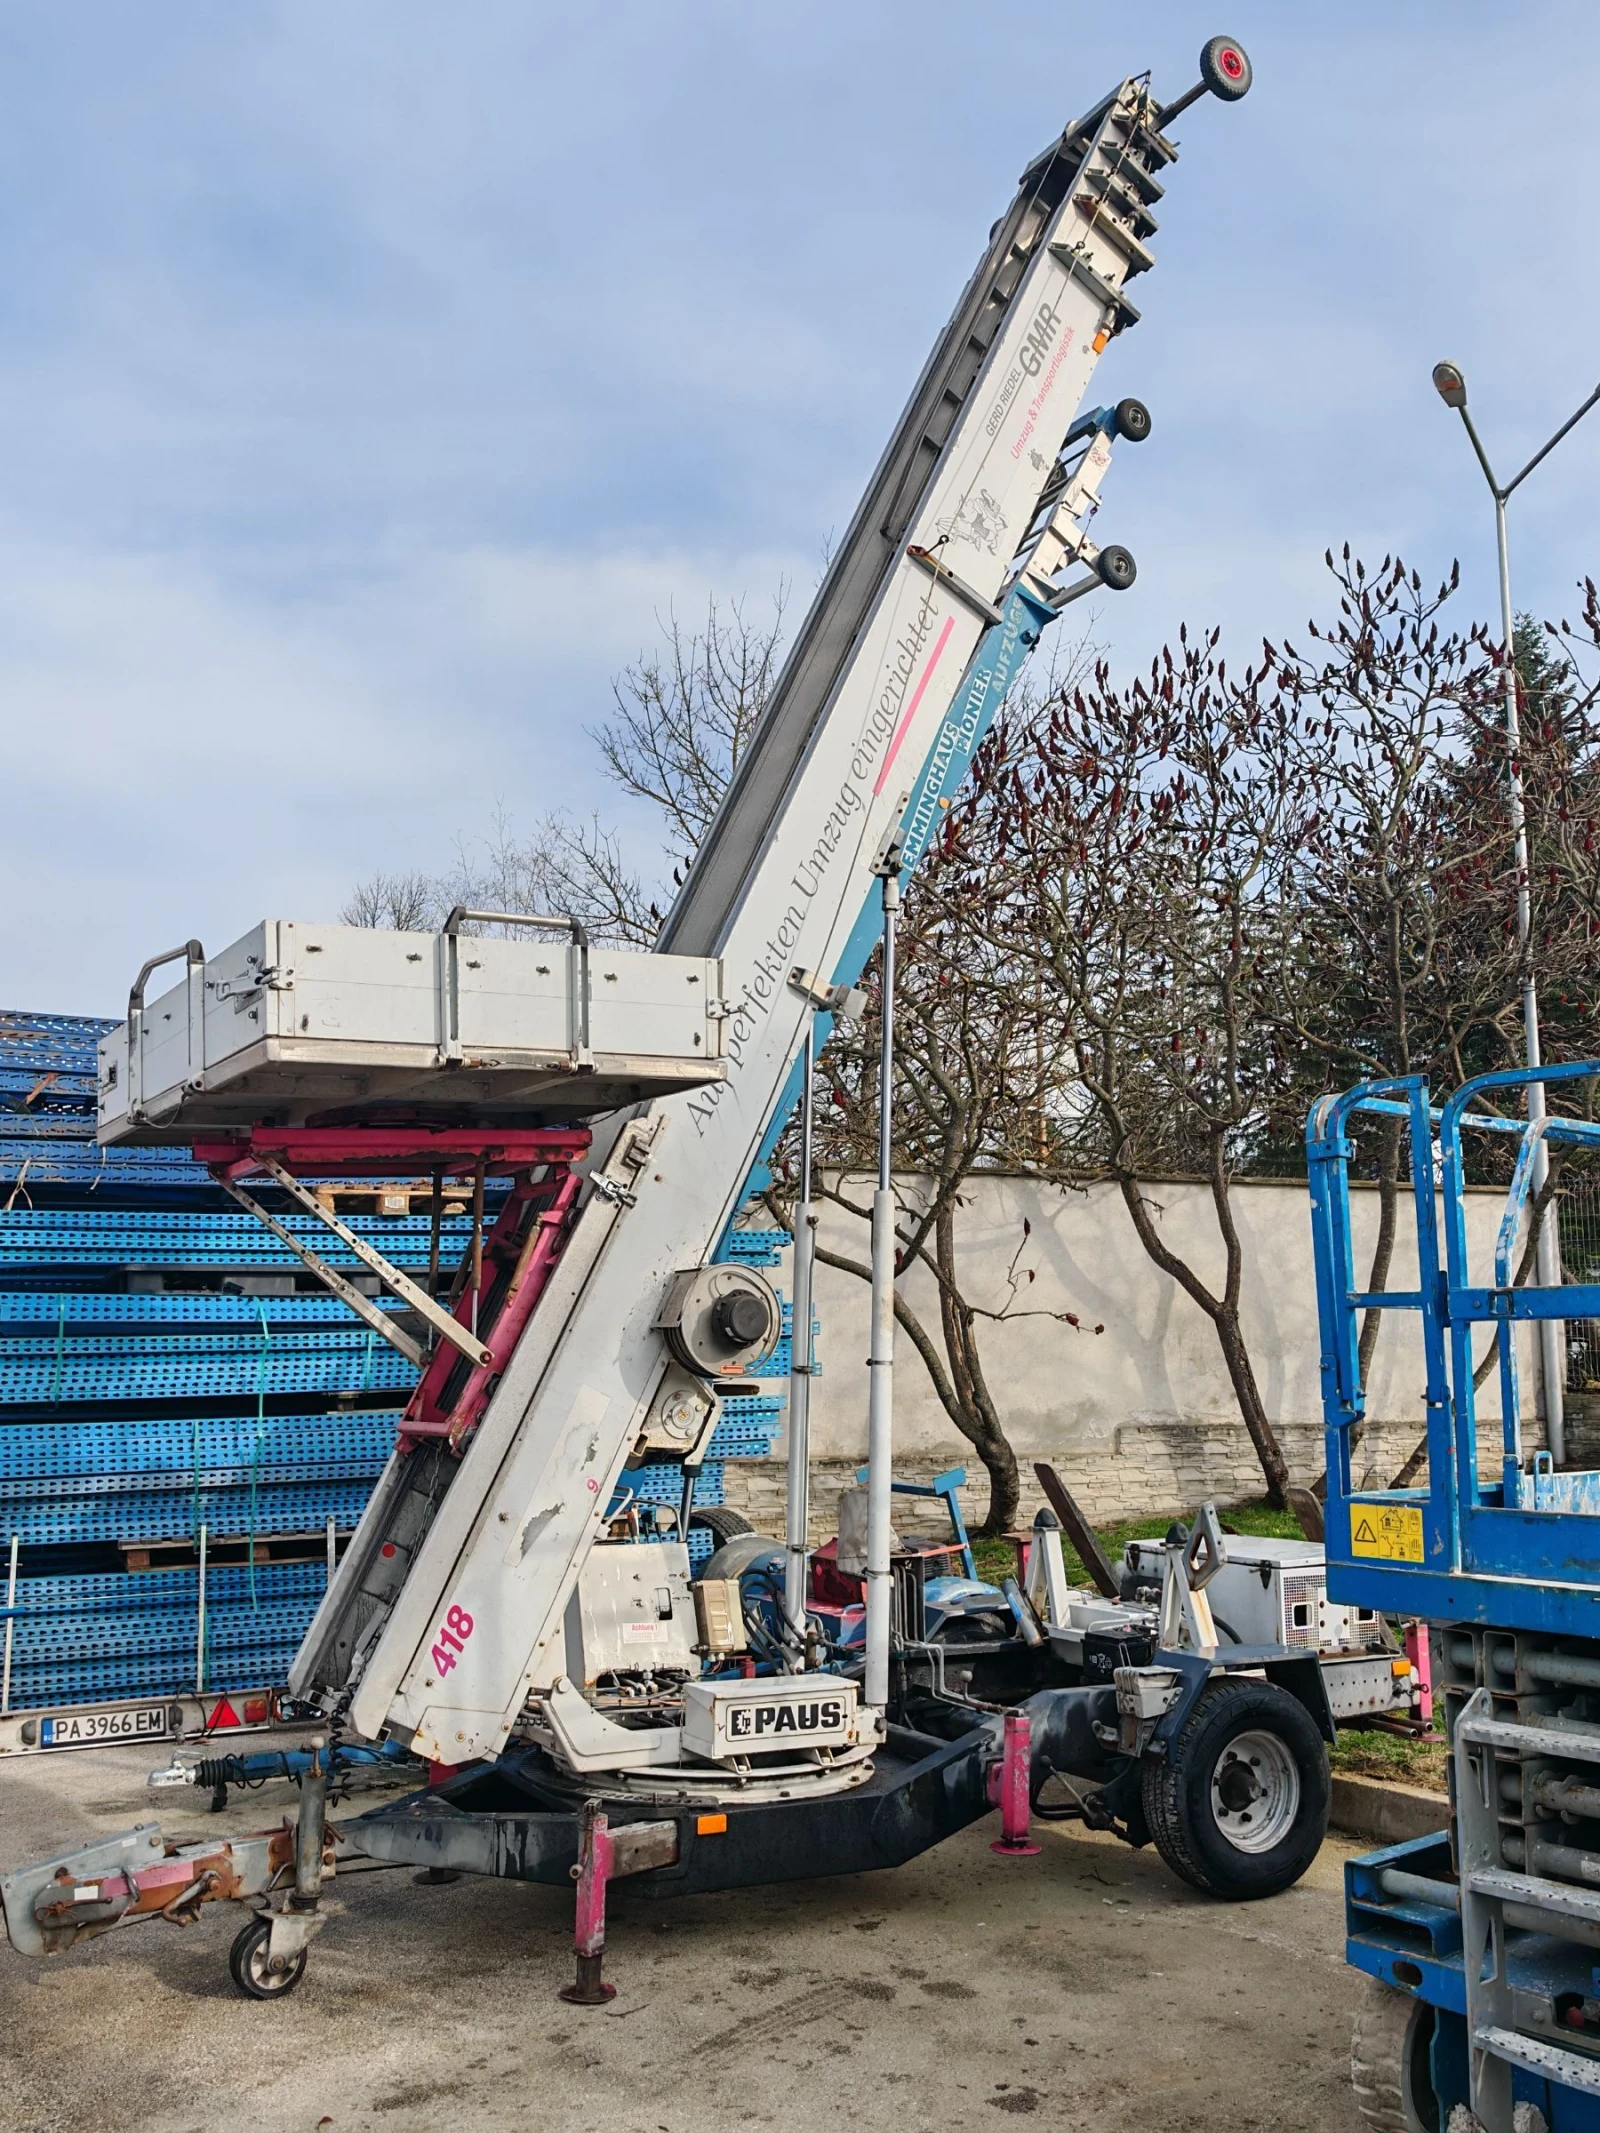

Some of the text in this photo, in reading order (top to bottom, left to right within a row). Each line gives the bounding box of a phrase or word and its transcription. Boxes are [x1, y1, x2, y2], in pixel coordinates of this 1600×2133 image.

[1019, 302, 1061, 378] GMR
[986, 367, 1021, 437] GERD RIEDEL
[1010, 326, 1076, 460] Umzug & Transportlogistik
[957, 669, 990, 756] PIONIER
[729, 904, 804, 1071] perfekten
[790, 782, 863, 898] Umzug
[851, 595, 939, 782] eingerichtet
[902, 722, 959, 868] EMMINGHAUS
[431, 1604, 474, 1678] 418
[56, 1711, 161, 1740] PA 3966 EM
[755, 1702, 840, 1734] PAUS
